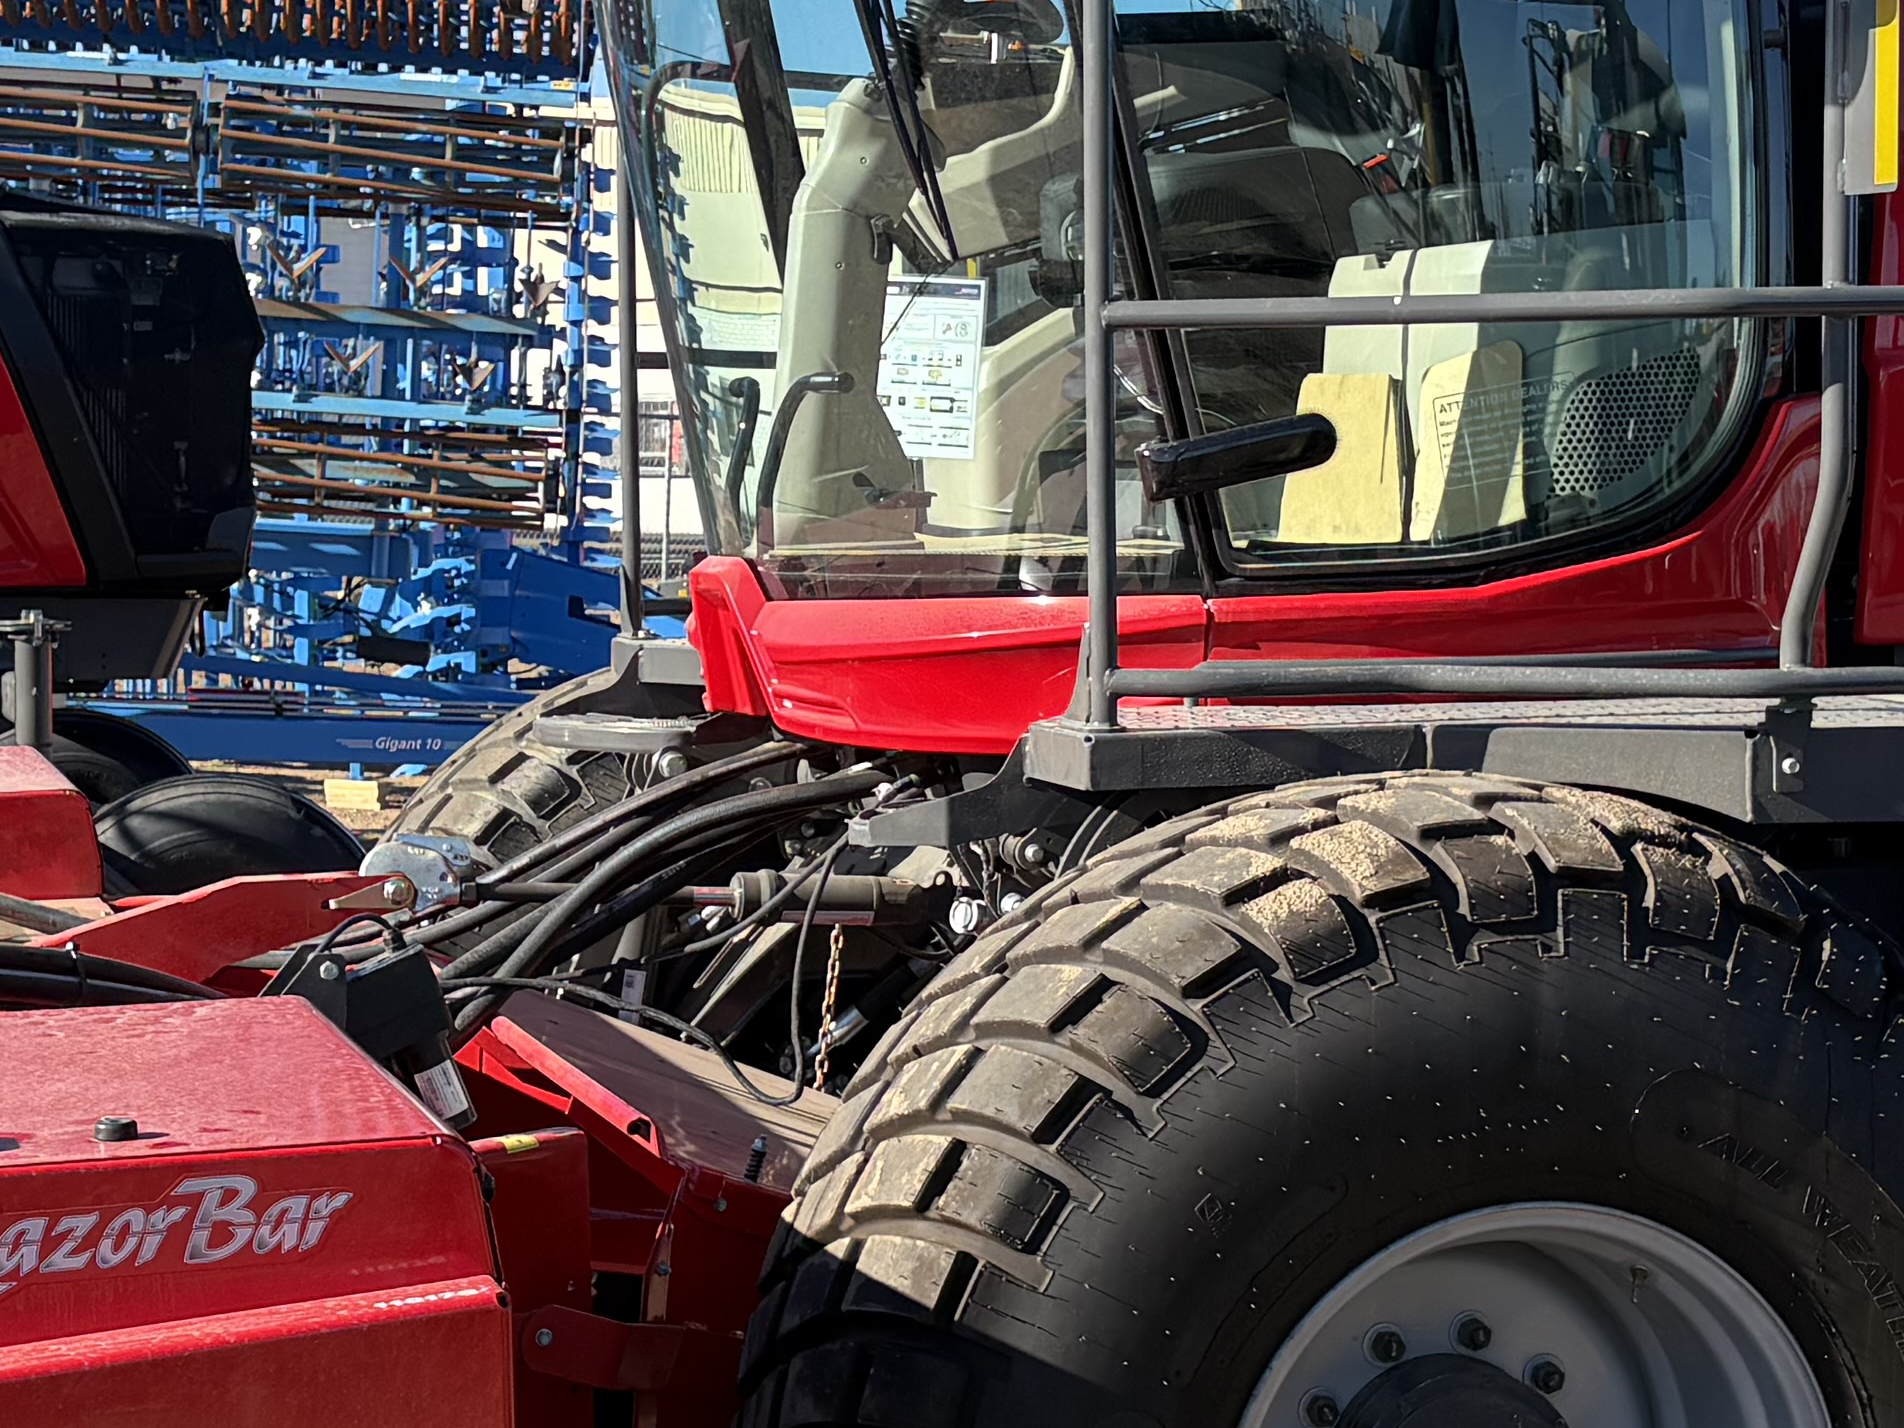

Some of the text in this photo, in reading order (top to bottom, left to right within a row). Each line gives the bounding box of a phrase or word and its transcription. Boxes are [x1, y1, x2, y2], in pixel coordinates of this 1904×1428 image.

[1438, 390, 1508, 414] ATTENTION
[375, 737, 442, 752] Gigant 10
